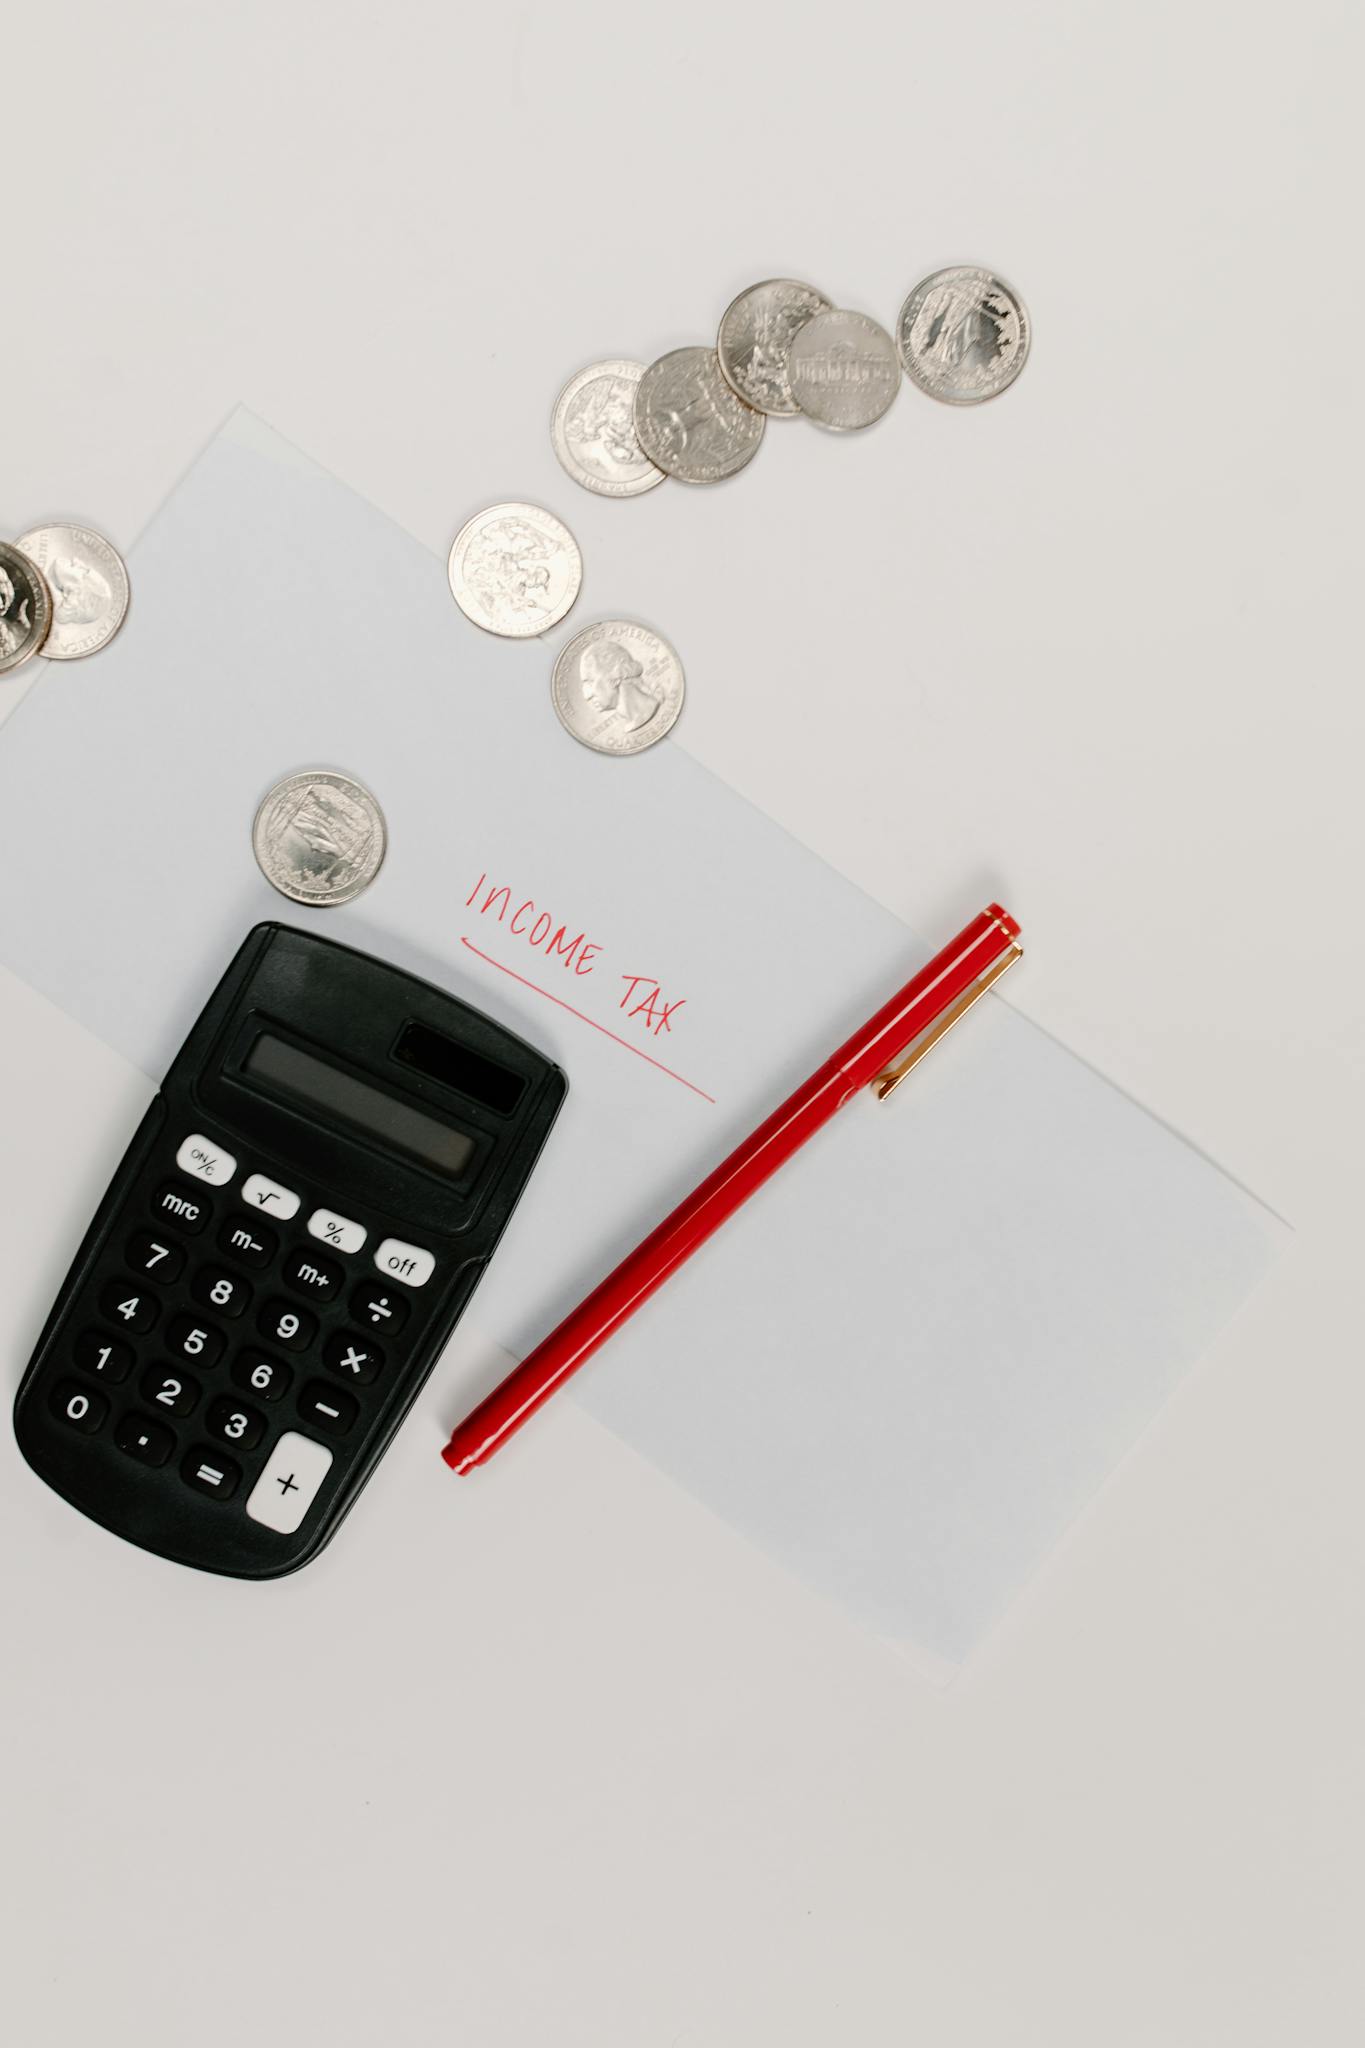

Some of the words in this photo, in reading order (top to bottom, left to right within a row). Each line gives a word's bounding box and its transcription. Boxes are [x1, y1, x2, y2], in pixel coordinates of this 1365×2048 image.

[466, 874, 604, 976] INCOME
[620, 975, 687, 1036] TAX
[161, 1193, 200, 1221] mrc
[324, 1222, 345, 1244] %
[145, 1243, 170, 1269] 7
[388, 1256, 417, 1276] off
[297, 1263, 330, 1287] m+
[209, 1279, 234, 1305] 8
[117, 1297, 140, 1321] 4
[276, 1313, 300, 1339] 9
[183, 1328, 208, 1355] 5
[96, 1347, 113, 1370] 1
[250, 1364, 273, 1389] 6
[155, 1378, 182, 1406] 2
[66, 1395, 89, 1420] 0
[224, 1413, 248, 1439] 3
